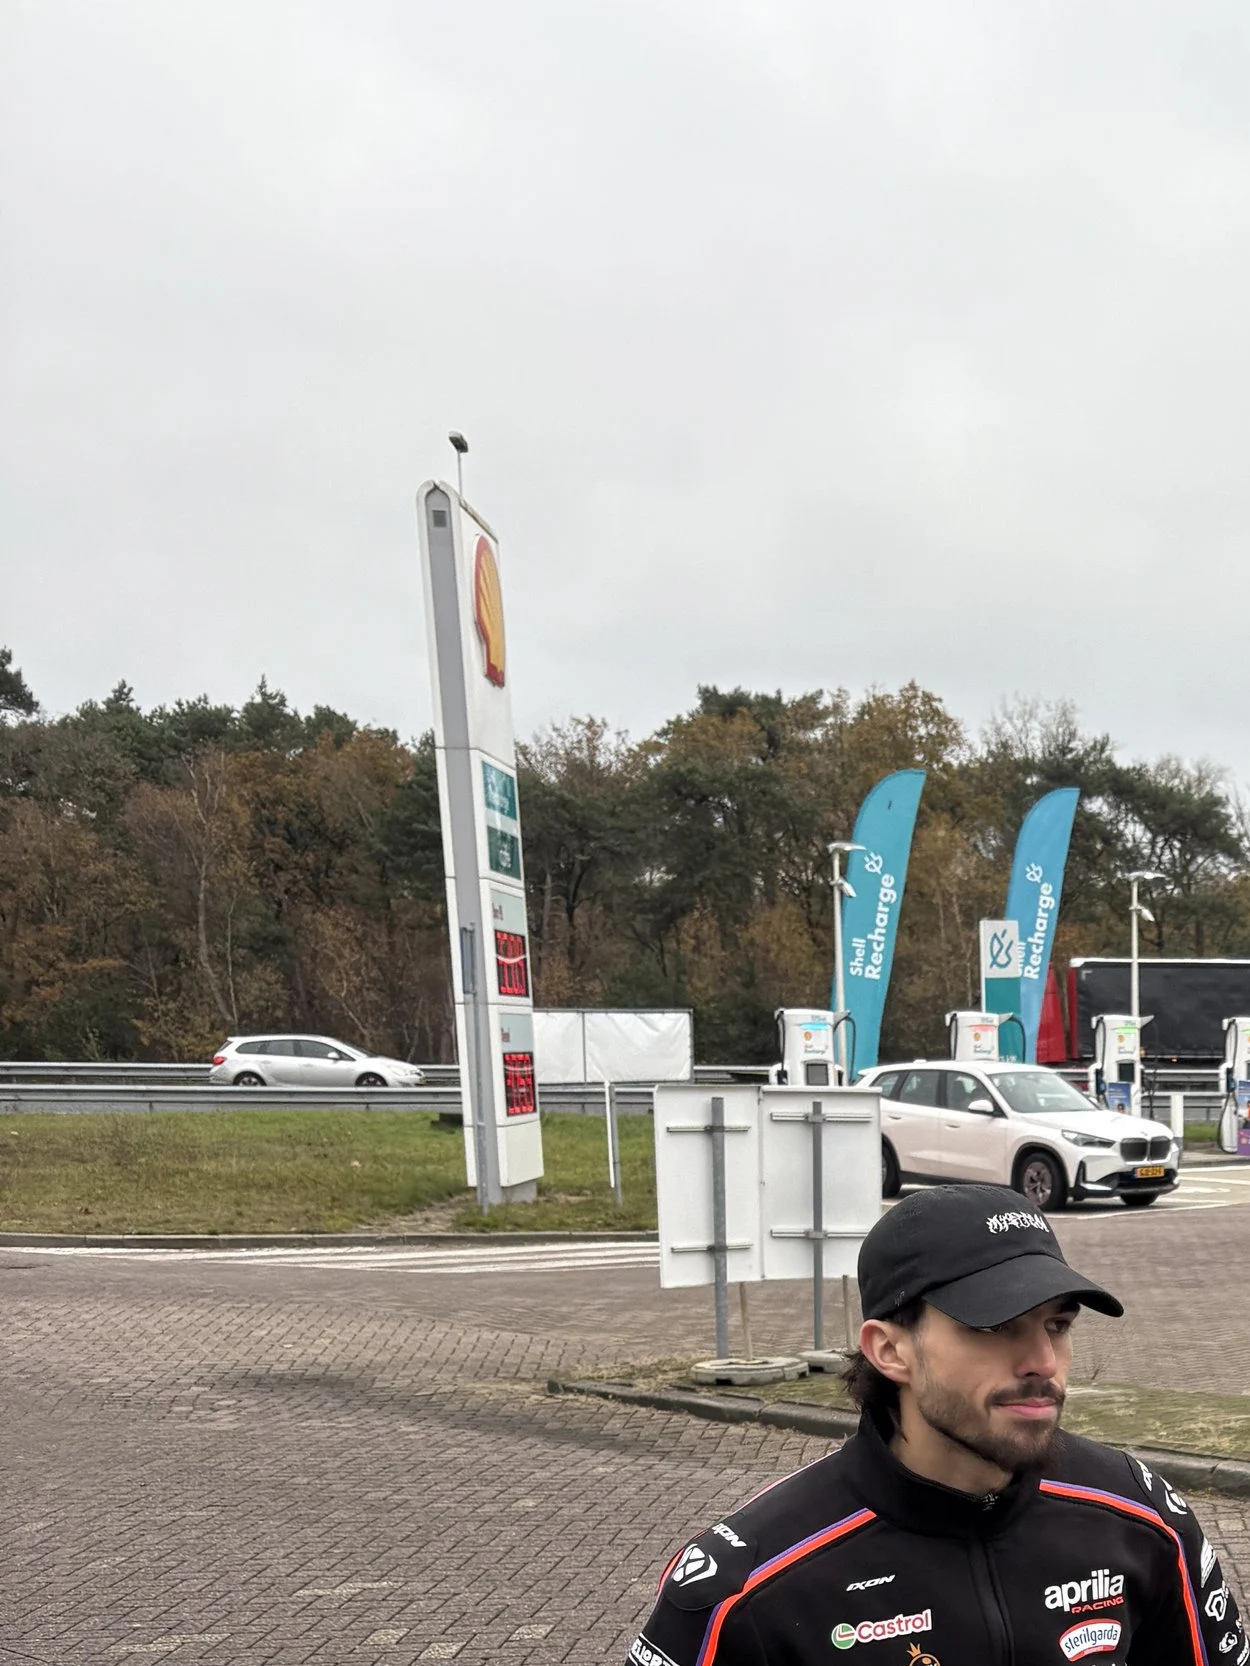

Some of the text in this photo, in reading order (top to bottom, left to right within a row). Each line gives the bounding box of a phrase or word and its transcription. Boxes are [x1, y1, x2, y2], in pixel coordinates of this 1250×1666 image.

[863, 873, 898, 980] Recharge
[1024, 882, 1056, 980] Recharge
[849, 937, 867, 977] Shell
[846, 1574, 896, 1592] IXON
[1044, 1568, 1125, 1613] aprilia
[1071, 1595, 1125, 1614] RACING
[856, 1611, 930, 1640] Castrol
[1064, 1624, 1119, 1653] sterilgarda
